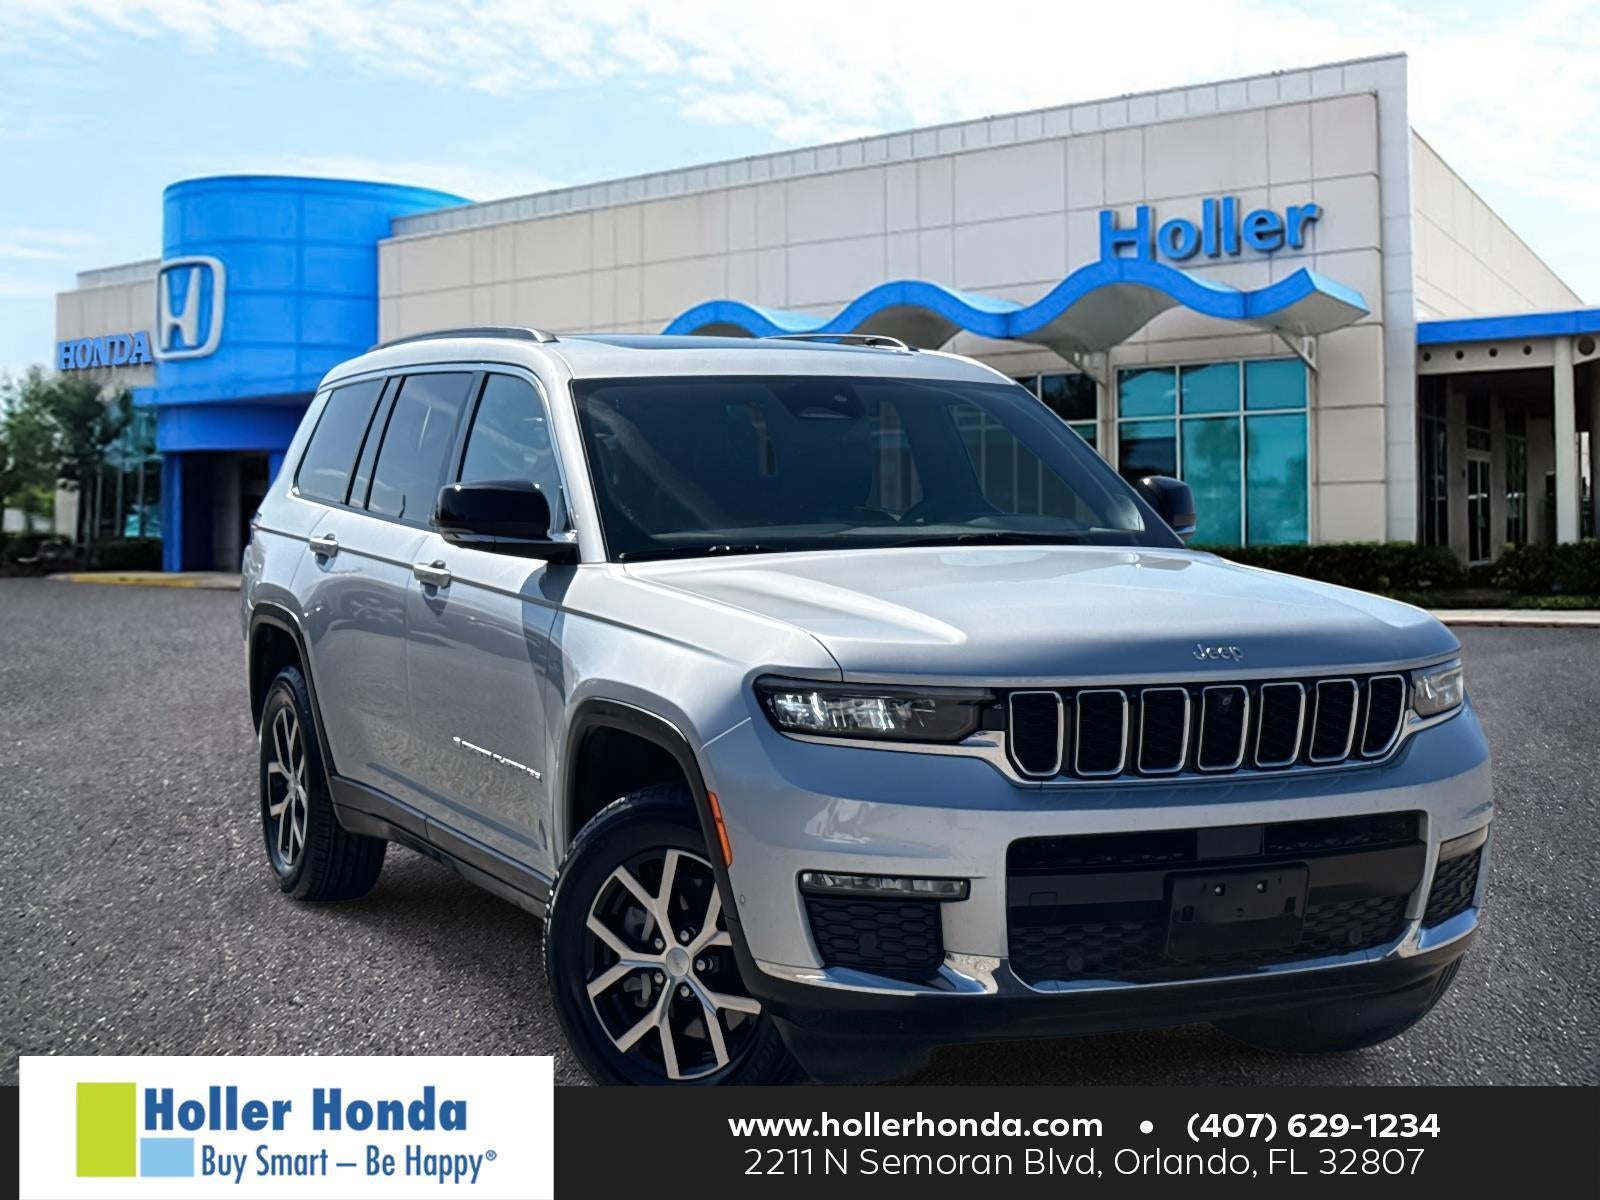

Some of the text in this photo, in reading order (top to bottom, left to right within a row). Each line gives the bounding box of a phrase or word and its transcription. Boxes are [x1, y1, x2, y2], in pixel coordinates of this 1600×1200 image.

[1099, 196, 1321, 263] Holler
[57, 330, 154, 370] HONDA
[1192, 643, 1244, 662] Jeep
